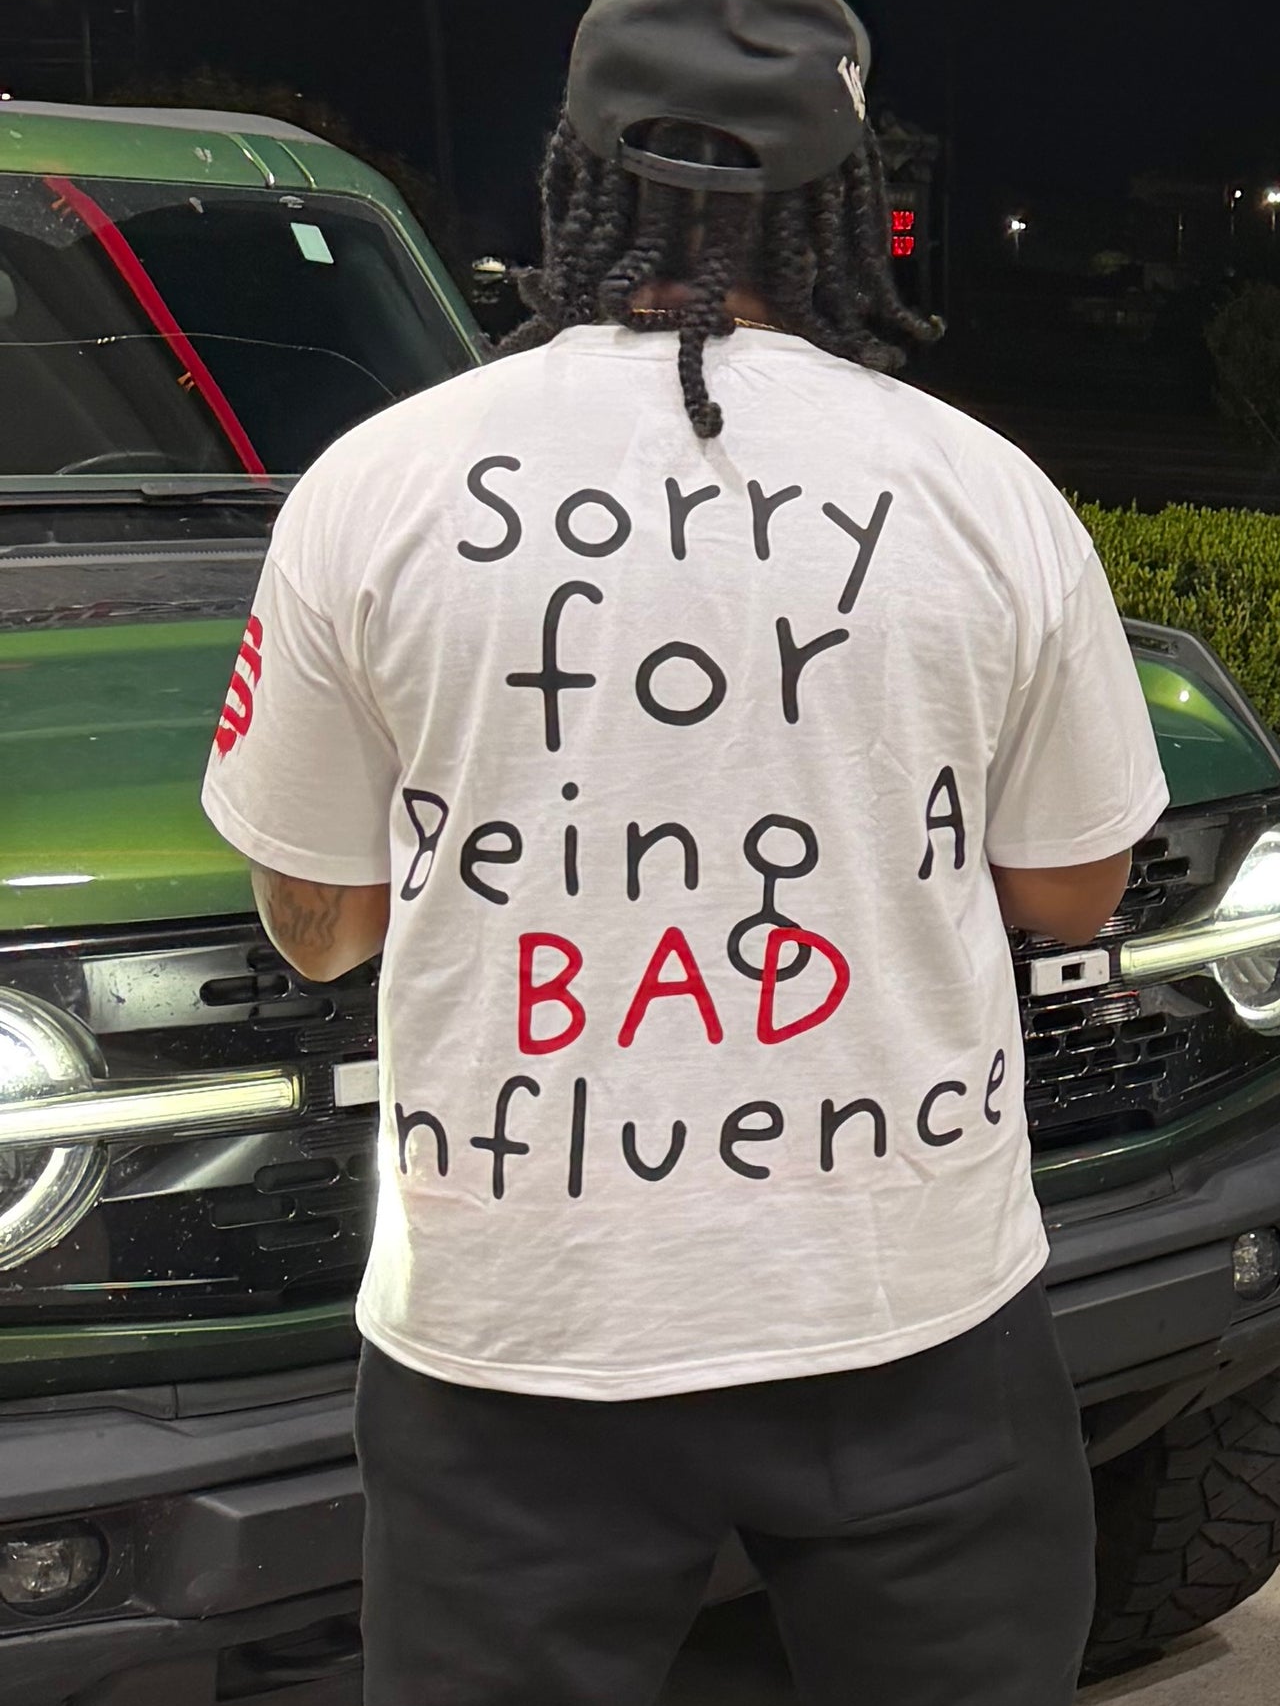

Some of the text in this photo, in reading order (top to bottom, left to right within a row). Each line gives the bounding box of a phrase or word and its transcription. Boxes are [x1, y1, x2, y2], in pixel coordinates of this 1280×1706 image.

[457, 455, 892, 614] Sorry
[505, 580, 850, 752] for
[401, 765, 965, 983] Being A
[517, 925, 851, 1055] BAD
[394, 1047, 1006, 1199] nfluence
